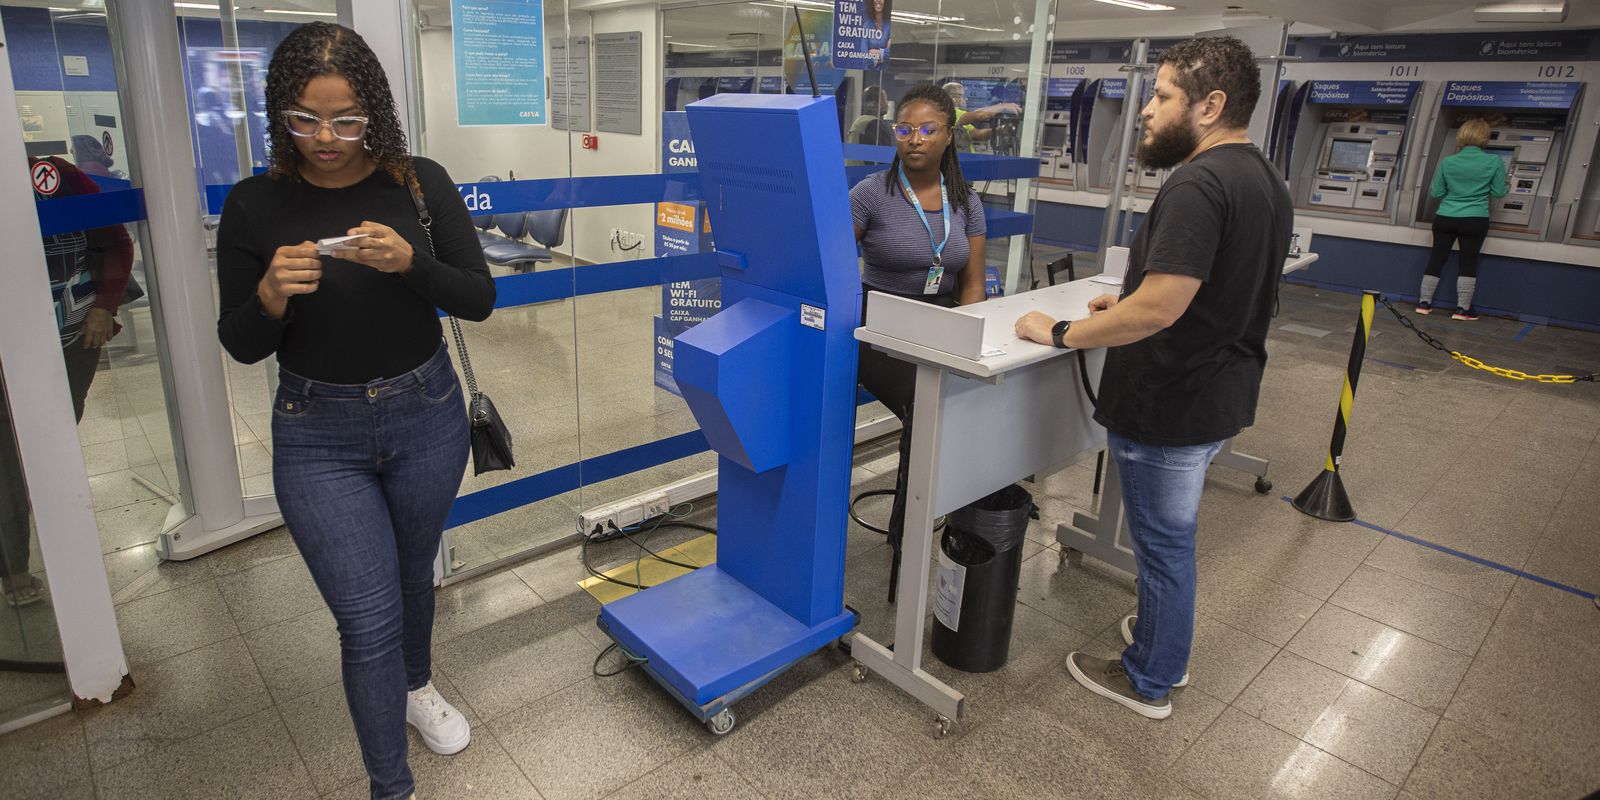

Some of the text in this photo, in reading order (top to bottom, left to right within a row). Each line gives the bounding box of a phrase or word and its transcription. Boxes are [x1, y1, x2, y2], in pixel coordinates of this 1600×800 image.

[839, 2, 857, 13] TEM
[839, 14, 862, 26] WI-FI
[838, 26, 882, 39] GRATUITO
[988, 66, 1004, 75] 1007
[1066, 66, 1085, 75] 1008
[1390, 66, 1419, 76] 1011
[1538, 65, 1575, 78] 1012
[1314, 82, 1340, 91] Saques
[1451, 83, 1482, 92] Saques
[1311, 90, 1349, 99] Depósitos
[1447, 93, 1494, 102] Depósitos
[661, 212, 692, 227] 2 milhões
[670, 289, 696, 298] WI-FI
[670, 298, 721, 308] GRATUITO
